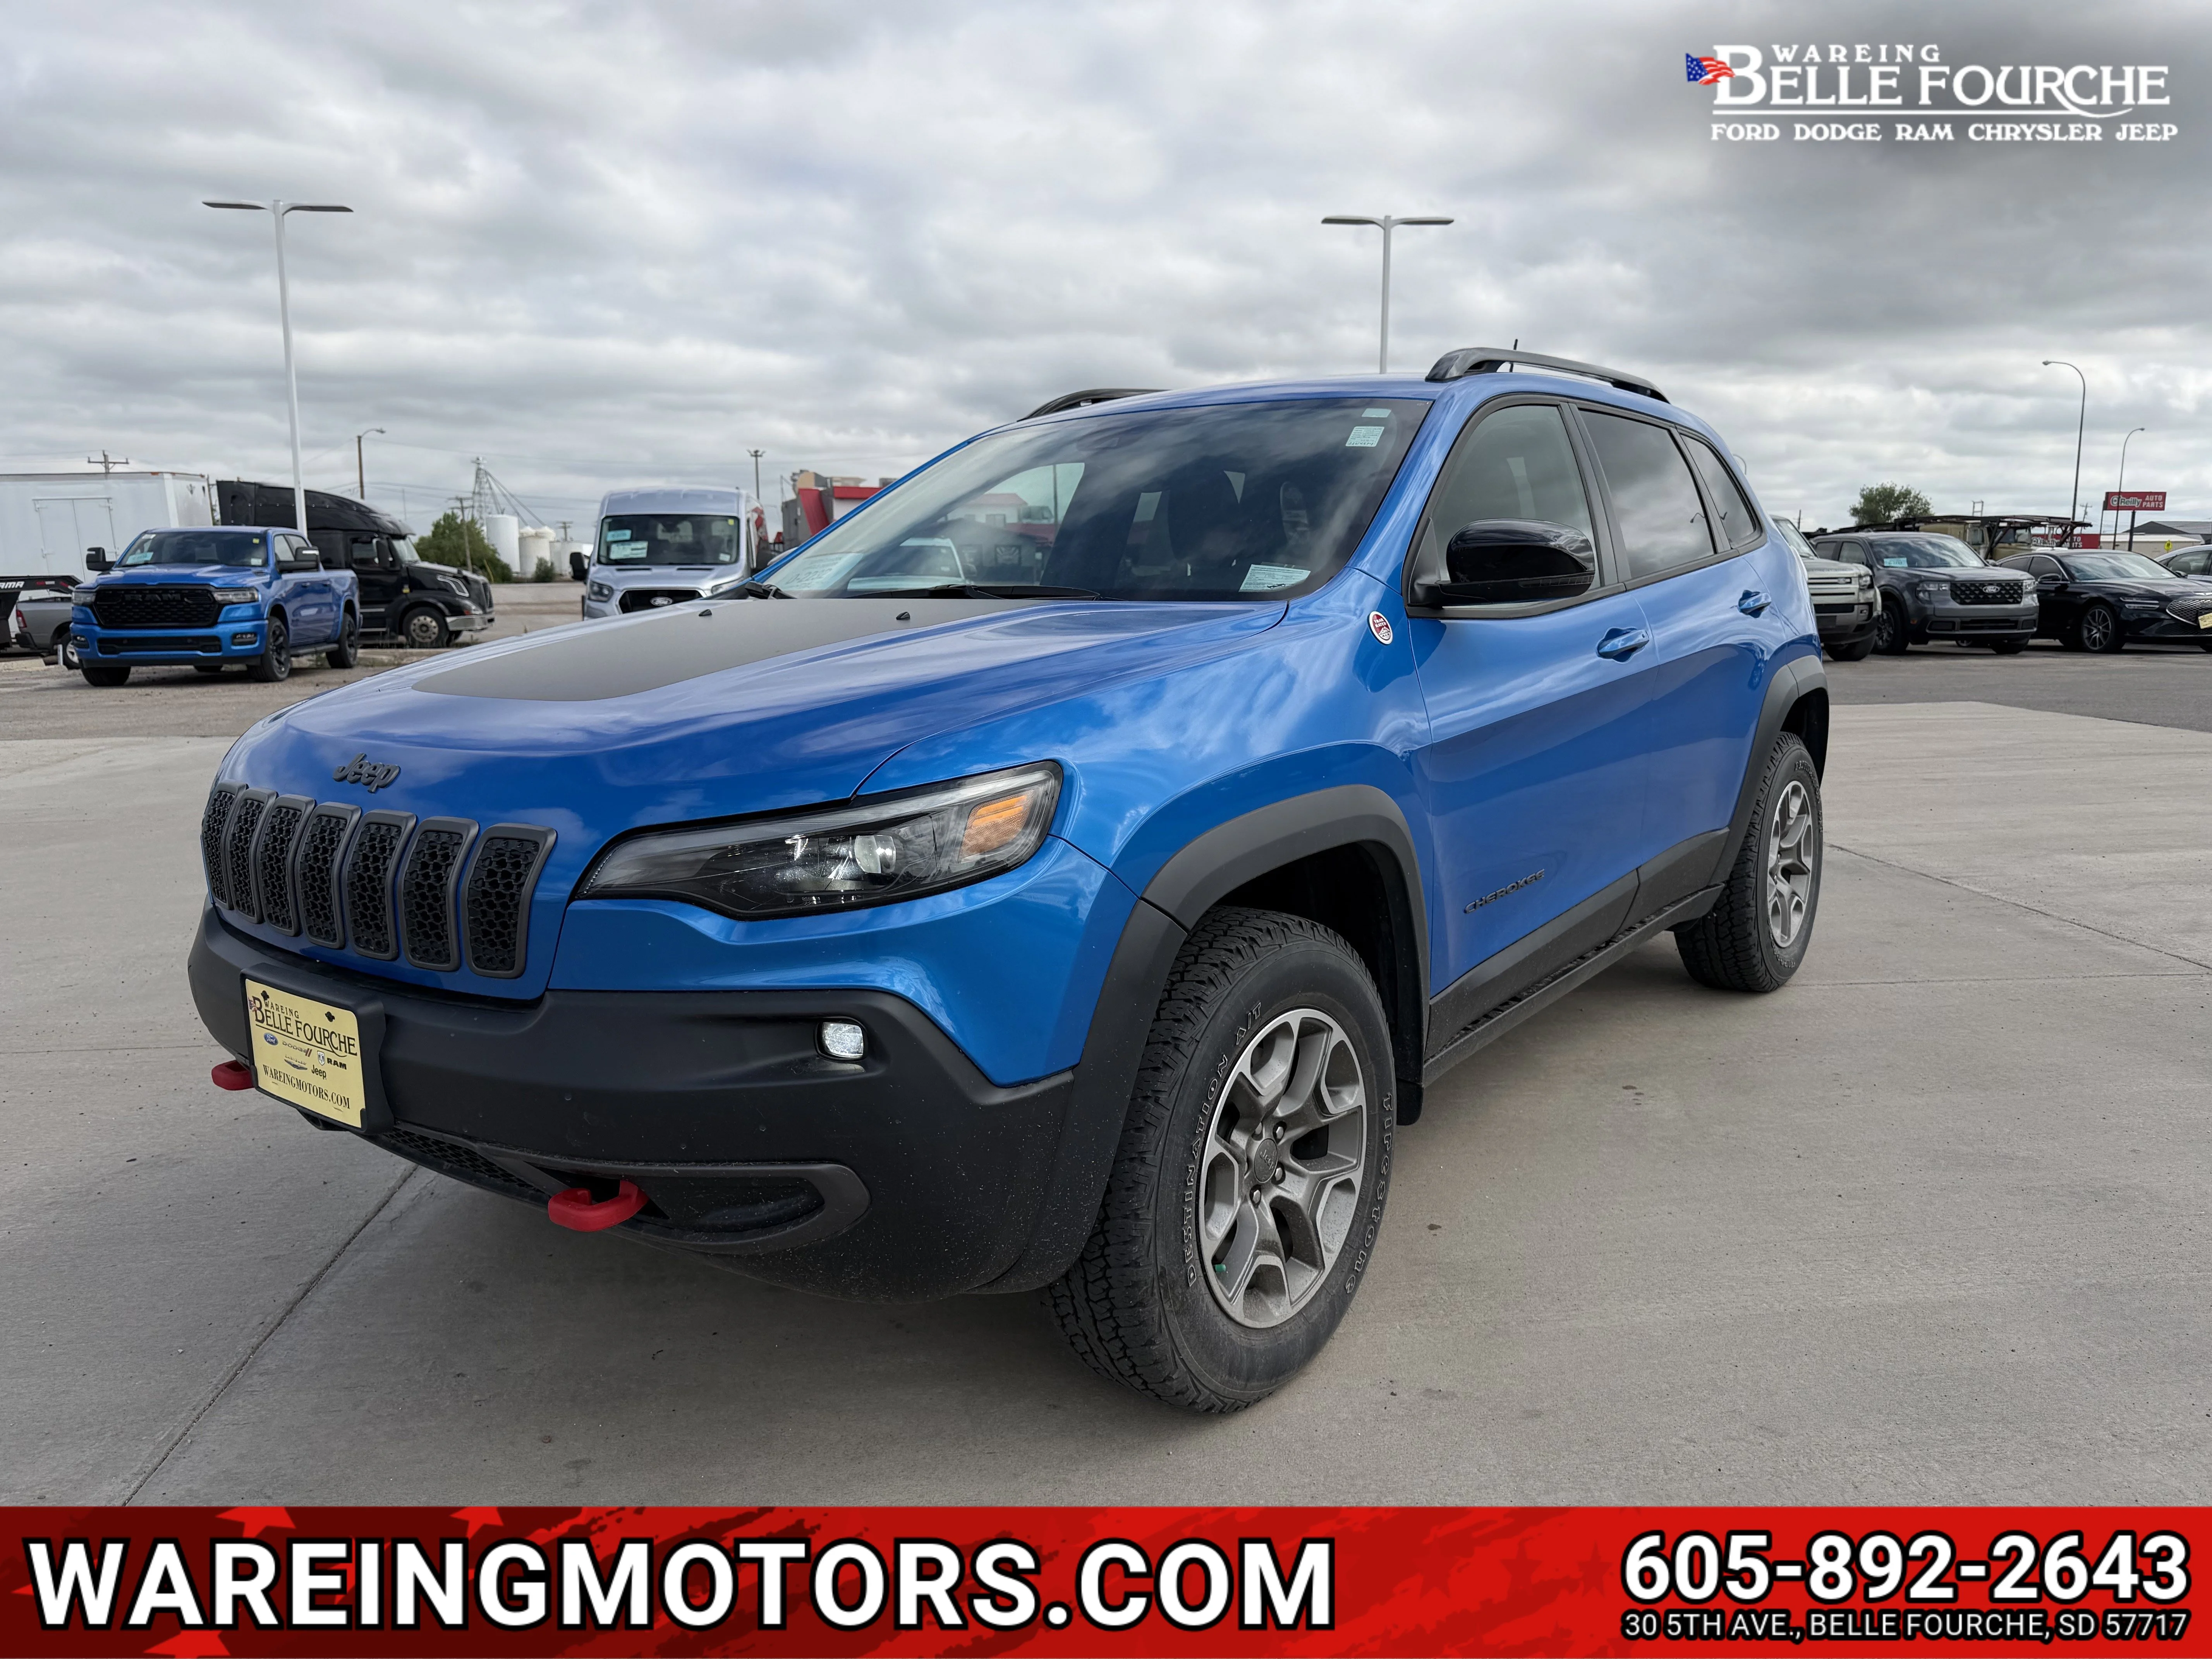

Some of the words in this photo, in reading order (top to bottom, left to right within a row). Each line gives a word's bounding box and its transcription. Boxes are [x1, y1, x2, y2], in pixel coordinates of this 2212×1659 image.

[333, 752, 401, 793] Jeep
[1463, 869, 1545, 914] CHEROKEE
[252, 996, 294, 1036] BELLE
[295, 1019, 357, 1057] FOURCHE
[264, 1000, 299, 1019] WAREING
[311, 1064, 327, 1080] Jeep
[327, 1057, 347, 1070] RAM
[263, 1064, 350, 1109] WAREINGMOTORS.COM
[1183, 1053, 1228, 1288] DESTINATION
[1236, 1002, 1262, 1046] A/T
